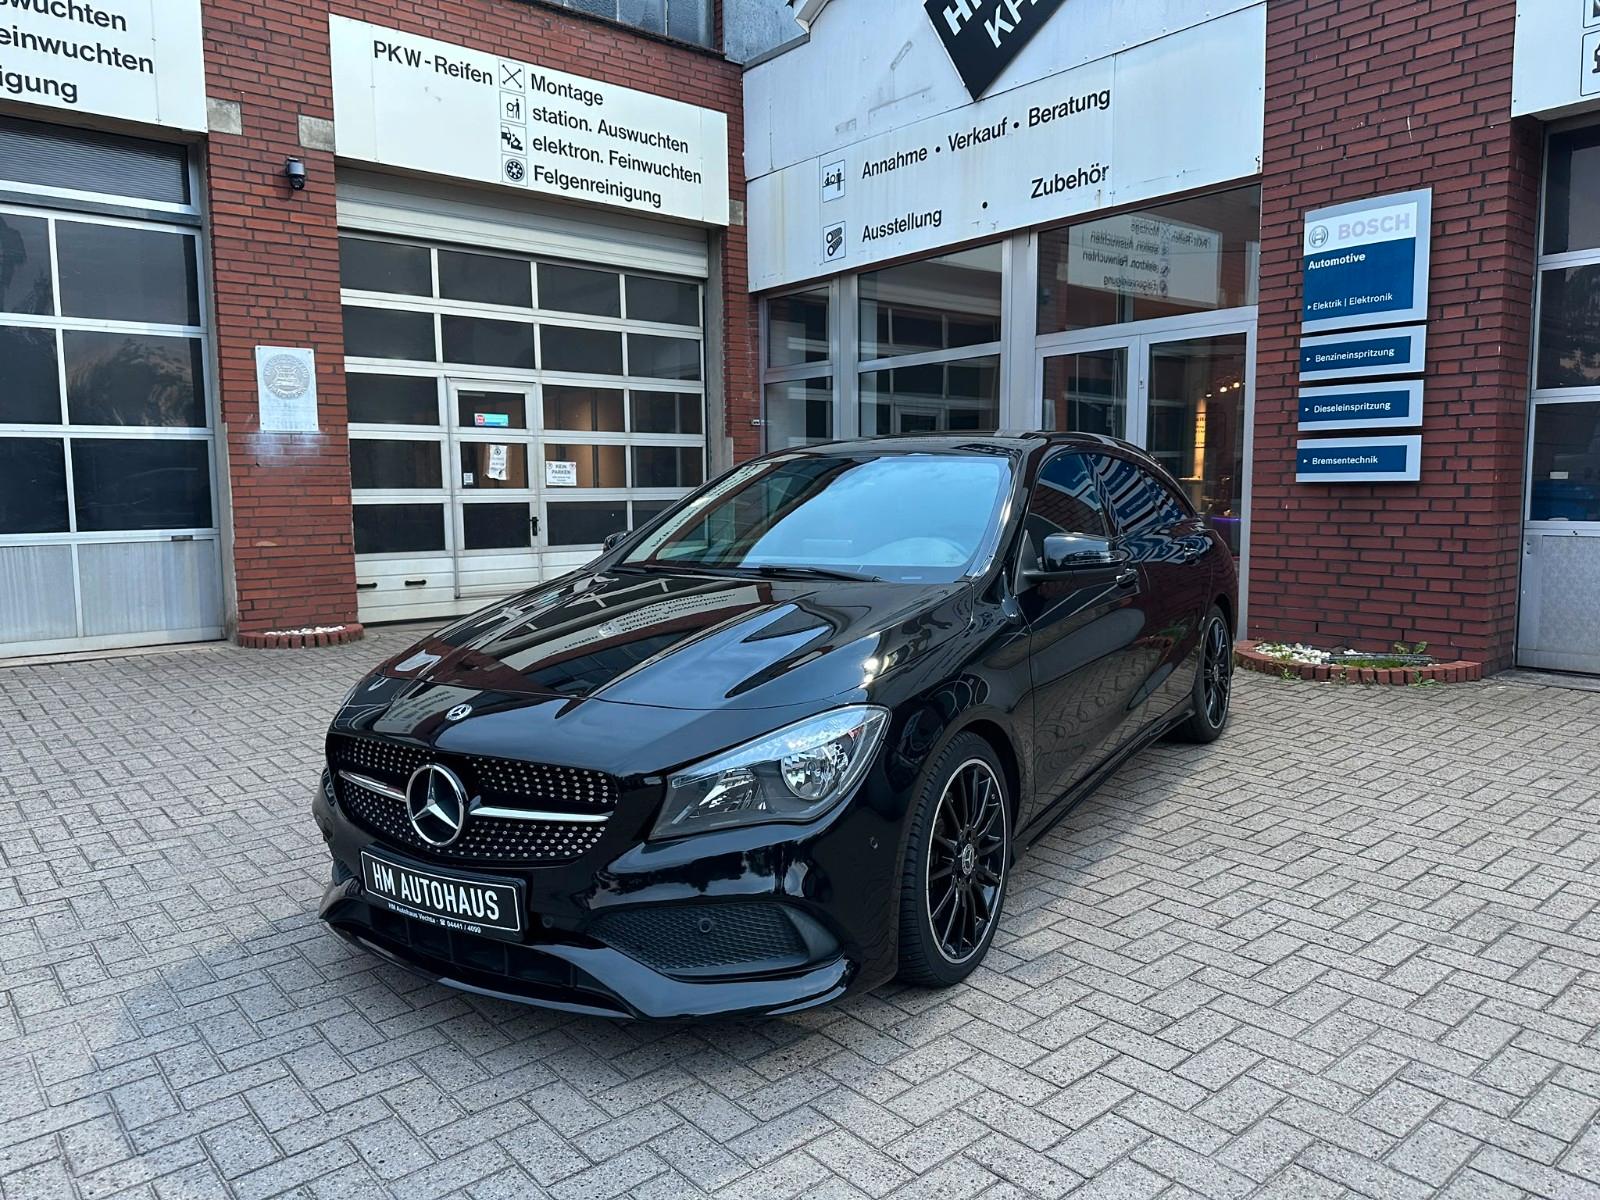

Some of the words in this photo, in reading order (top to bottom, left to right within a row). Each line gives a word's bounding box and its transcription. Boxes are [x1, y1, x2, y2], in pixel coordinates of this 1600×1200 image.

[0, 0, 127, 32] wuchten
[373, 40, 493, 86] PKW-Reifen
[531, 73, 604, 106] Montage
[532, 106, 593, 133] station.
[597, 119, 689, 154] Auswuchten
[861, 144, 928, 180] Annahme
[947, 117, 1008, 153] Verkauf
[1028, 88, 1111, 128] Beratung
[532, 136, 604, 165] elektron.
[609, 151, 702, 185] Feinwuchten
[534, 165, 662, 209] Felgenreinigung
[1030, 162, 1109, 200] Zubehör
[861, 208, 943, 243] Ausstellung
[1338, 212, 1411, 241] BOSCH
[1308, 252, 1366, 270] Automotive
[1312, 298, 1343, 311] Elektrik
[1349, 293, 1393, 306] Elektronik
[1315, 348, 1395, 364] Benzineinspritzung
[1313, 401, 1391, 414] Dieseleinspritzung
[1312, 456, 1378, 466] Bremsentechnik
[372, 861, 396, 896] HM
[401, 873, 500, 921] AUTOHAUS
